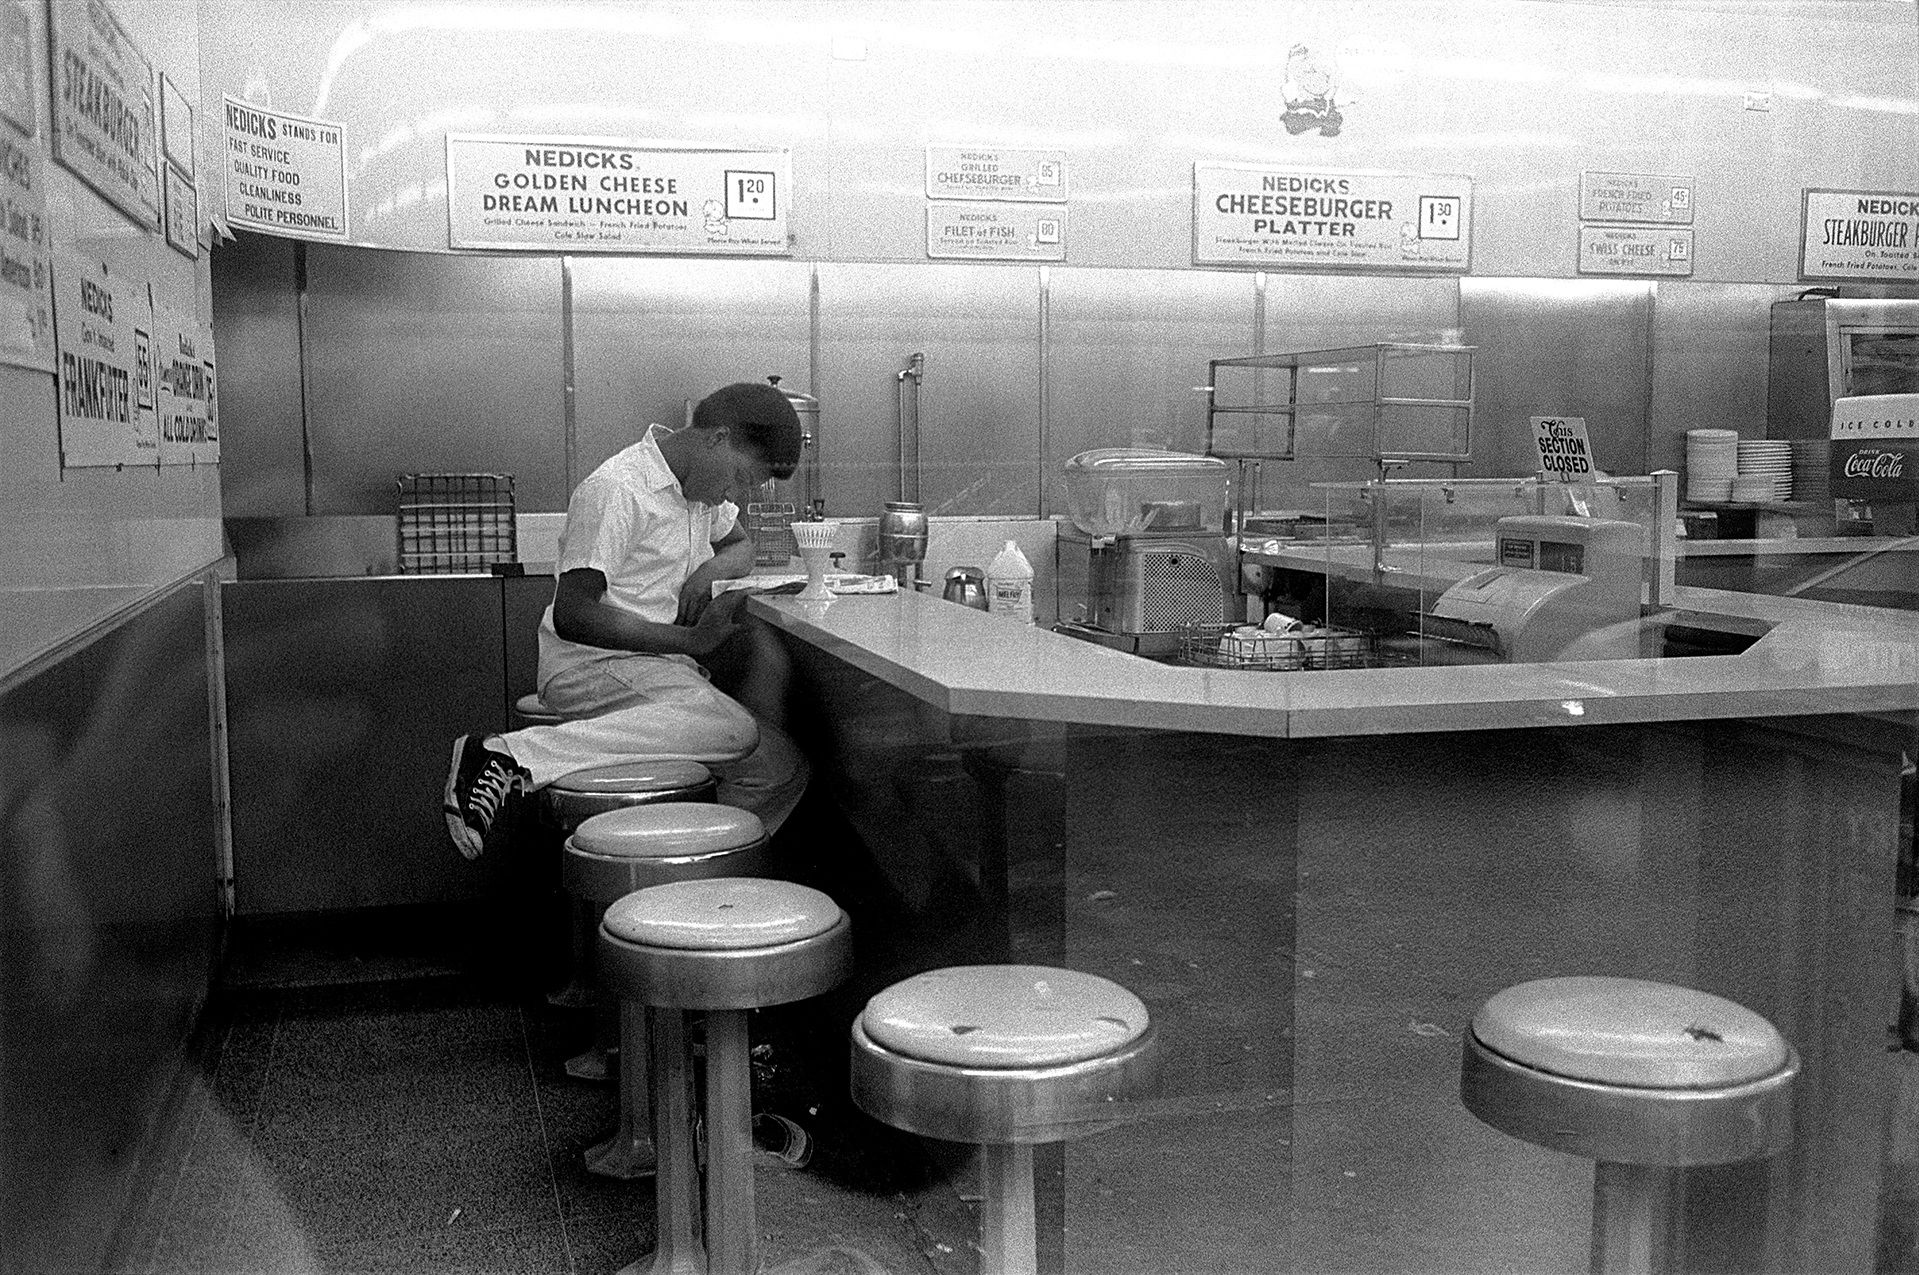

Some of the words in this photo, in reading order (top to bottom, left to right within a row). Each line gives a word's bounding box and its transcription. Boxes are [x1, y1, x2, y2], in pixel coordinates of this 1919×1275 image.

[226, 104, 277, 140] NEDICKS
[282, 123, 316, 141] STANDS
[320, 131, 338, 145] FOR
[229, 136, 247, 154] FAST
[250, 144, 290, 165] SERVICE
[525, 149, 633, 170] NEDICKS
[234, 159, 268, 179] QUALITY
[272, 169, 300, 186] FOOD
[960, 163, 999, 173] GRILLED
[494, 173, 587, 191] GOLDEN
[600, 175, 677, 194] CHEESE
[937, 172, 1021, 186] CHEESEBURGER
[1262, 176, 1350, 195] NEDICKS
[239, 182, 302, 206] CLEANLINESS
[483, 194, 558, 213] DREAM
[569, 197, 688, 217] LUNCHEON
[1216, 193, 1393, 220] CHEESEBURGER
[1858, 199, 1919, 216] NEDICK
[245, 203, 274, 221] POLITE
[277, 210, 339, 230] PERSONNEL
[944, 225, 975, 237] FILET
[989, 225, 1015, 238] FISH
[1254, 219, 1356, 237] PLATTER
[1823, 218, 1908, 248] STEAKBURGER
[1589, 242, 1618, 255] SWISS
[1622, 244, 1656, 257] CHEESE
[1864, 250, 1876, 258] On
[1880, 250, 1910, 259] Toasted
[1821, 260, 1845, 269] French
[1846, 261, 1865, 269] Fried
[1541, 419, 1573, 438] This
[1840, 420, 1863, 430] ICE
[1873, 419, 1915, 429] COLD
[1538, 436, 1586, 455] SECTION
[1543, 454, 1589, 473] CLOSED
[1844, 452, 1905, 478] Coca-Cola
